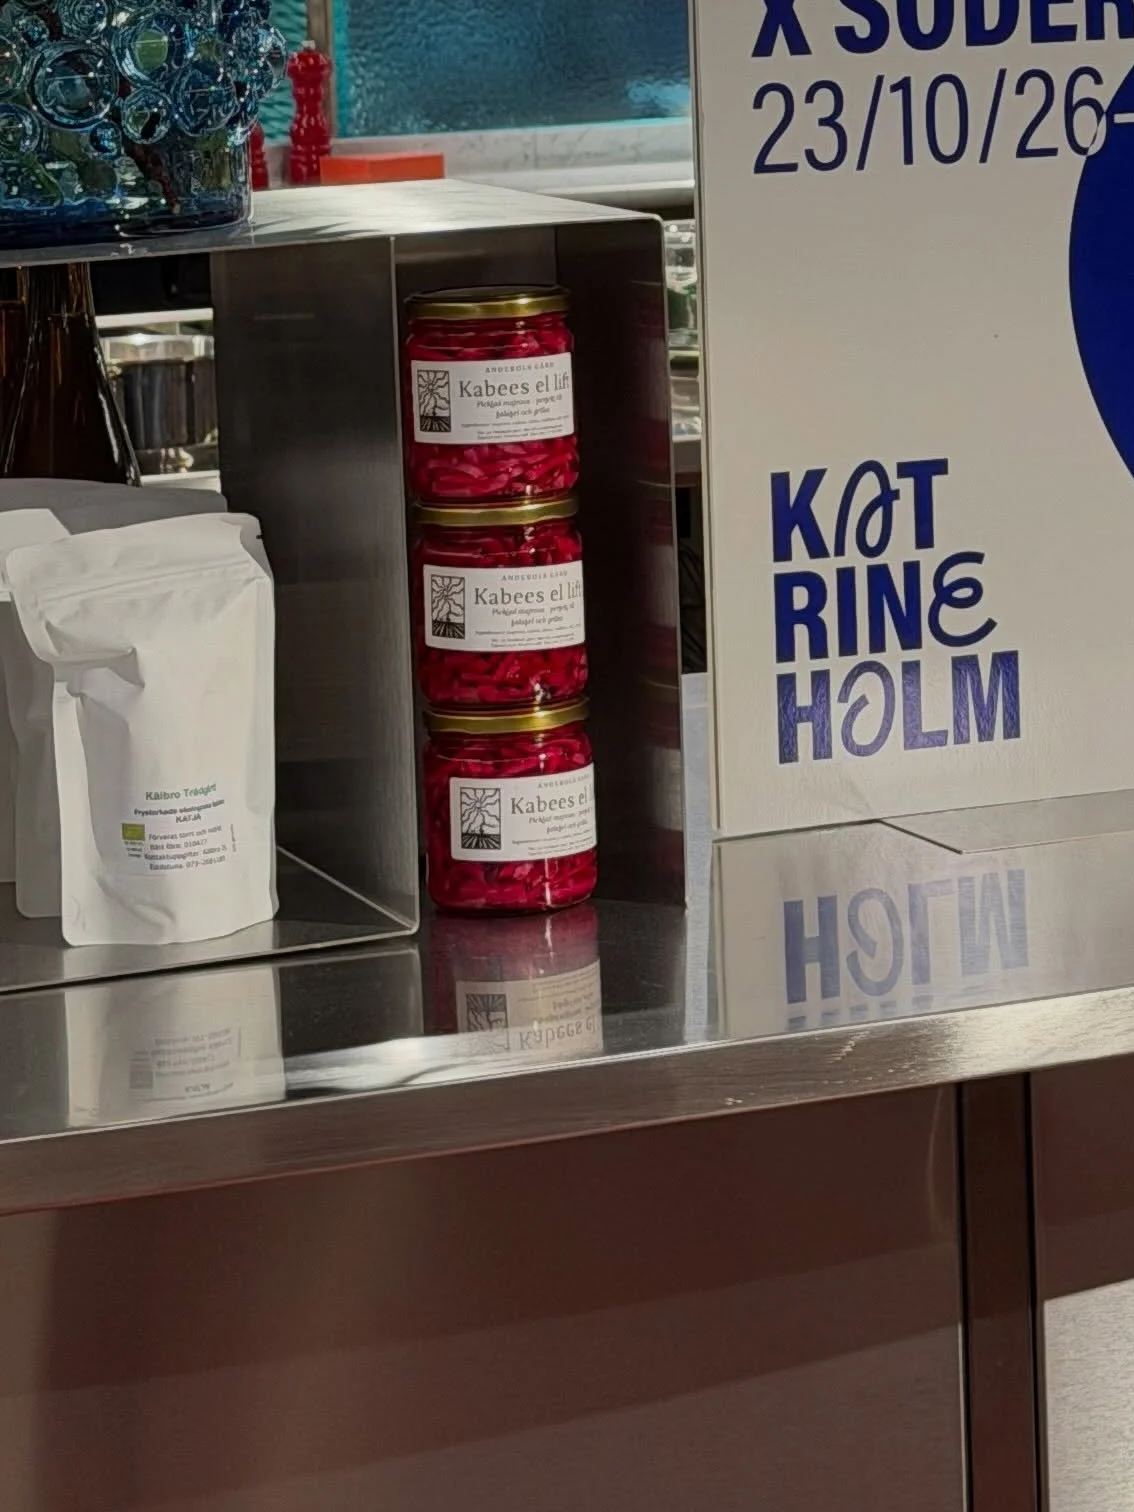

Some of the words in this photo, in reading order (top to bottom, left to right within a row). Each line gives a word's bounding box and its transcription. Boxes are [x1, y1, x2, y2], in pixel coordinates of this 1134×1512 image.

[459, 379, 530, 398] Kabees
[536, 375, 550, 393] el
[770, 457, 949, 562] KAT
[474, 587, 545, 605] Kabees
[550, 583, 563, 601] el
[773, 551, 997, 663] RINE
[778, 650, 1022, 764] HOLM
[511, 795, 575, 815] Kabees
[578, 786, 588, 805] el
